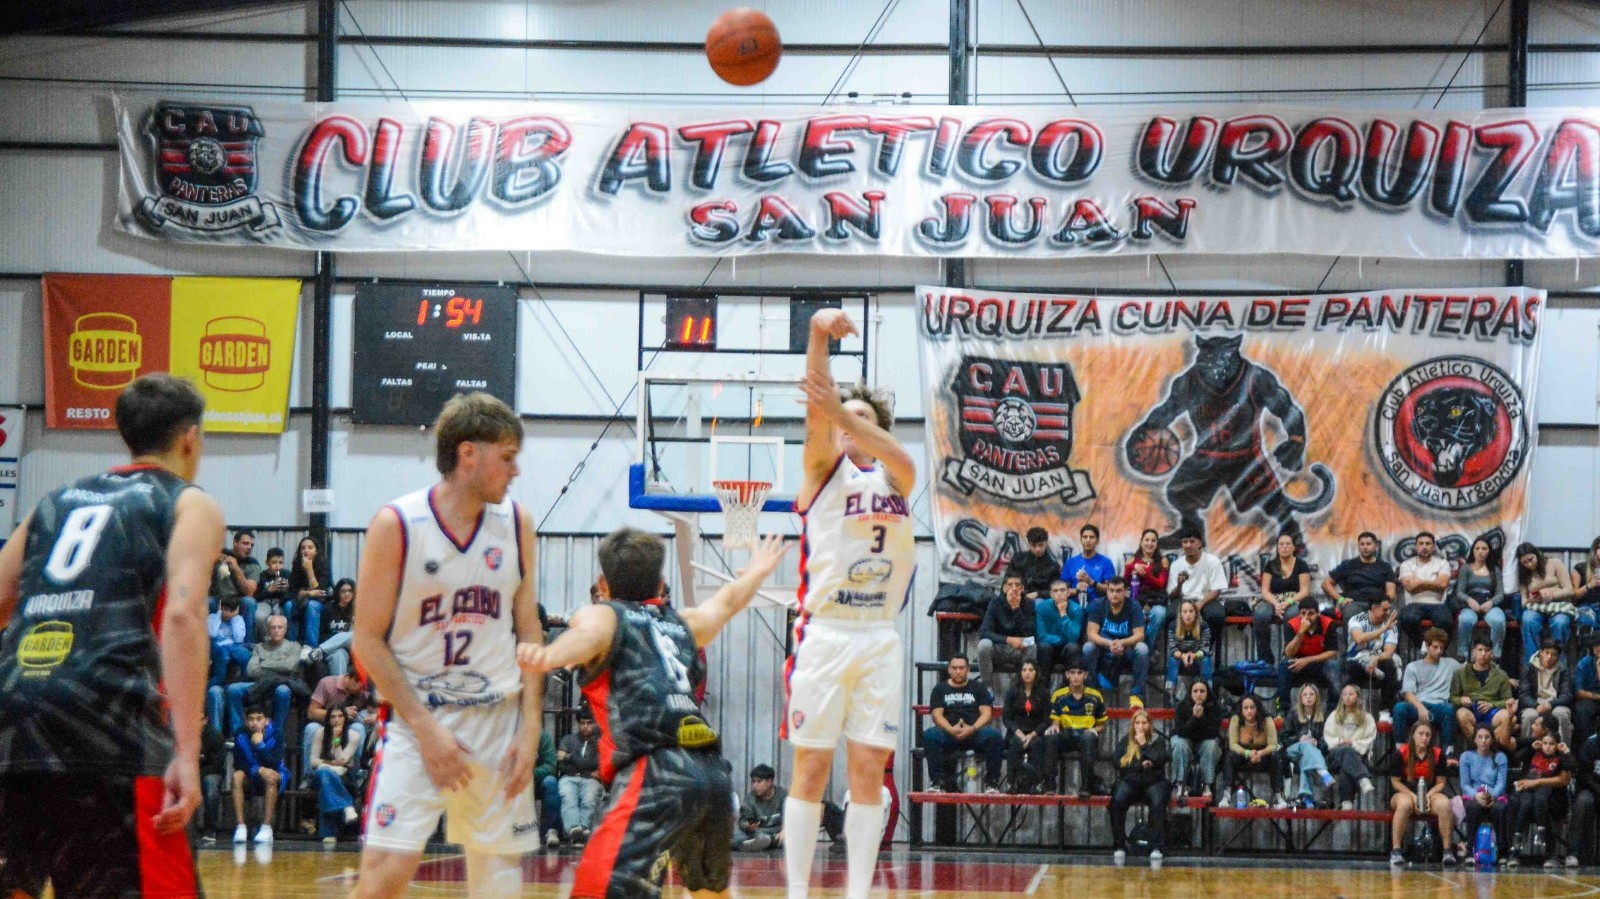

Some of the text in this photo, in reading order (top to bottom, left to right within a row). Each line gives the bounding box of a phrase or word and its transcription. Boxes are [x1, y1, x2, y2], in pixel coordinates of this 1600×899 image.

[163, 110, 249, 133] CAU
[168, 177, 248, 201] PANTERAS
[297, 115, 1600, 236] CLUB ATLETICO URQUIZA
[164, 202, 252, 225] SAN JUAN
[690, 191, 1196, 243] SAN JUAN
[423, 289, 456, 297] TIEMPO
[417, 297, 483, 328] 1:54
[924, 293, 1541, 339] URQUIZA CUNA DE PANTERAS
[385, 331, 413, 339] LOCAL
[682, 315, 711, 344] 11
[72, 338, 139, 364] GARDEN
[202, 342, 269, 368] GARDEN
[382, 378, 412, 386] FALTAS
[457, 380, 487, 388] FALTAS
[969, 363, 1063, 398] CAU
[67, 408, 110, 419] RESTO
[1382, 389, 1405, 420] Club
[972, 438, 1060, 470] PANTERAS
[1388, 451, 1410, 482] San
[970, 464, 1064, 494] SAN JUAN
[844, 492, 867, 517] EL
[46, 504, 114, 580] 8
[870, 525, 887, 553] 3
[419, 594, 446, 626] EL
[444, 630, 473, 666] 12
